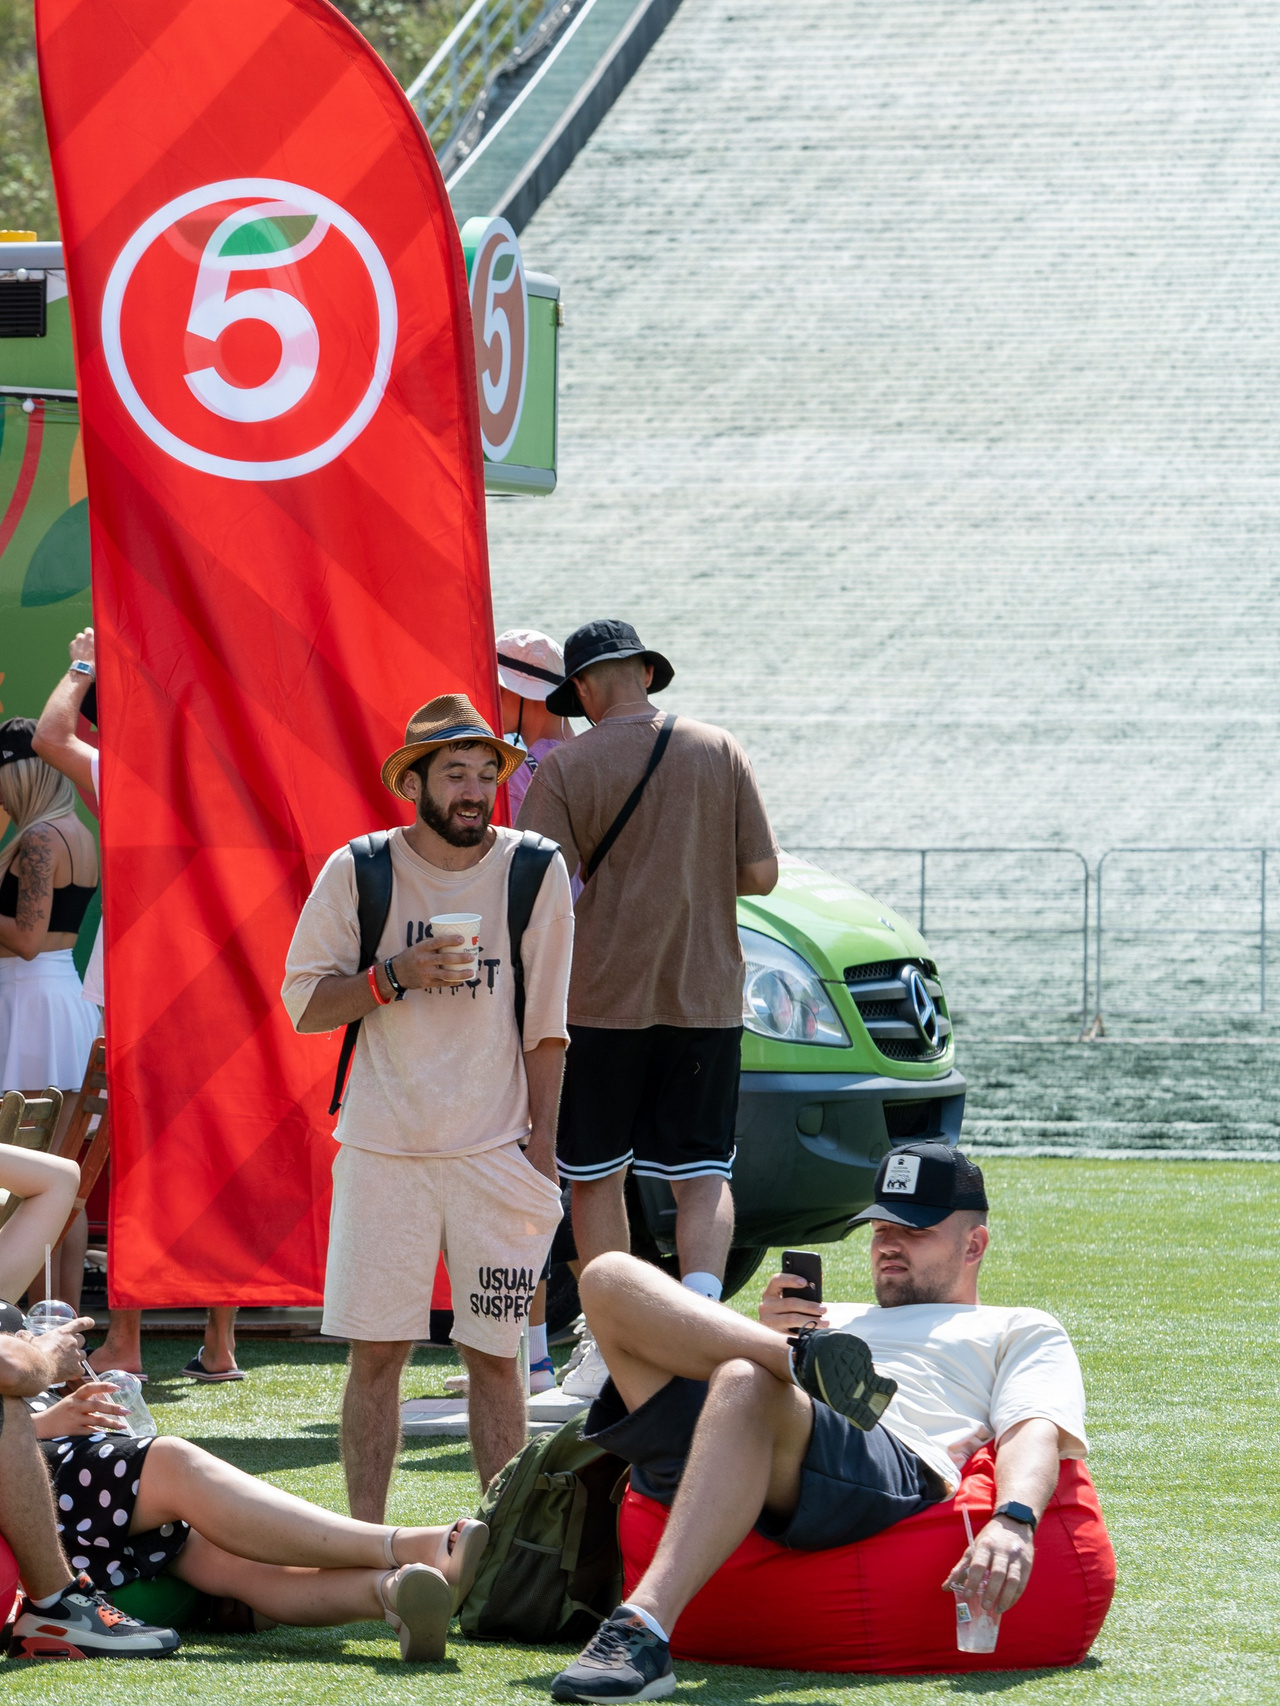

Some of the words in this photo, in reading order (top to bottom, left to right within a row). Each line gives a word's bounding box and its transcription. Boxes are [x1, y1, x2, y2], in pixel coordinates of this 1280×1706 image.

[182, 200, 331, 422] 5
[481, 241, 517, 415] 5
[478, 1266, 536, 1294] USUAL
